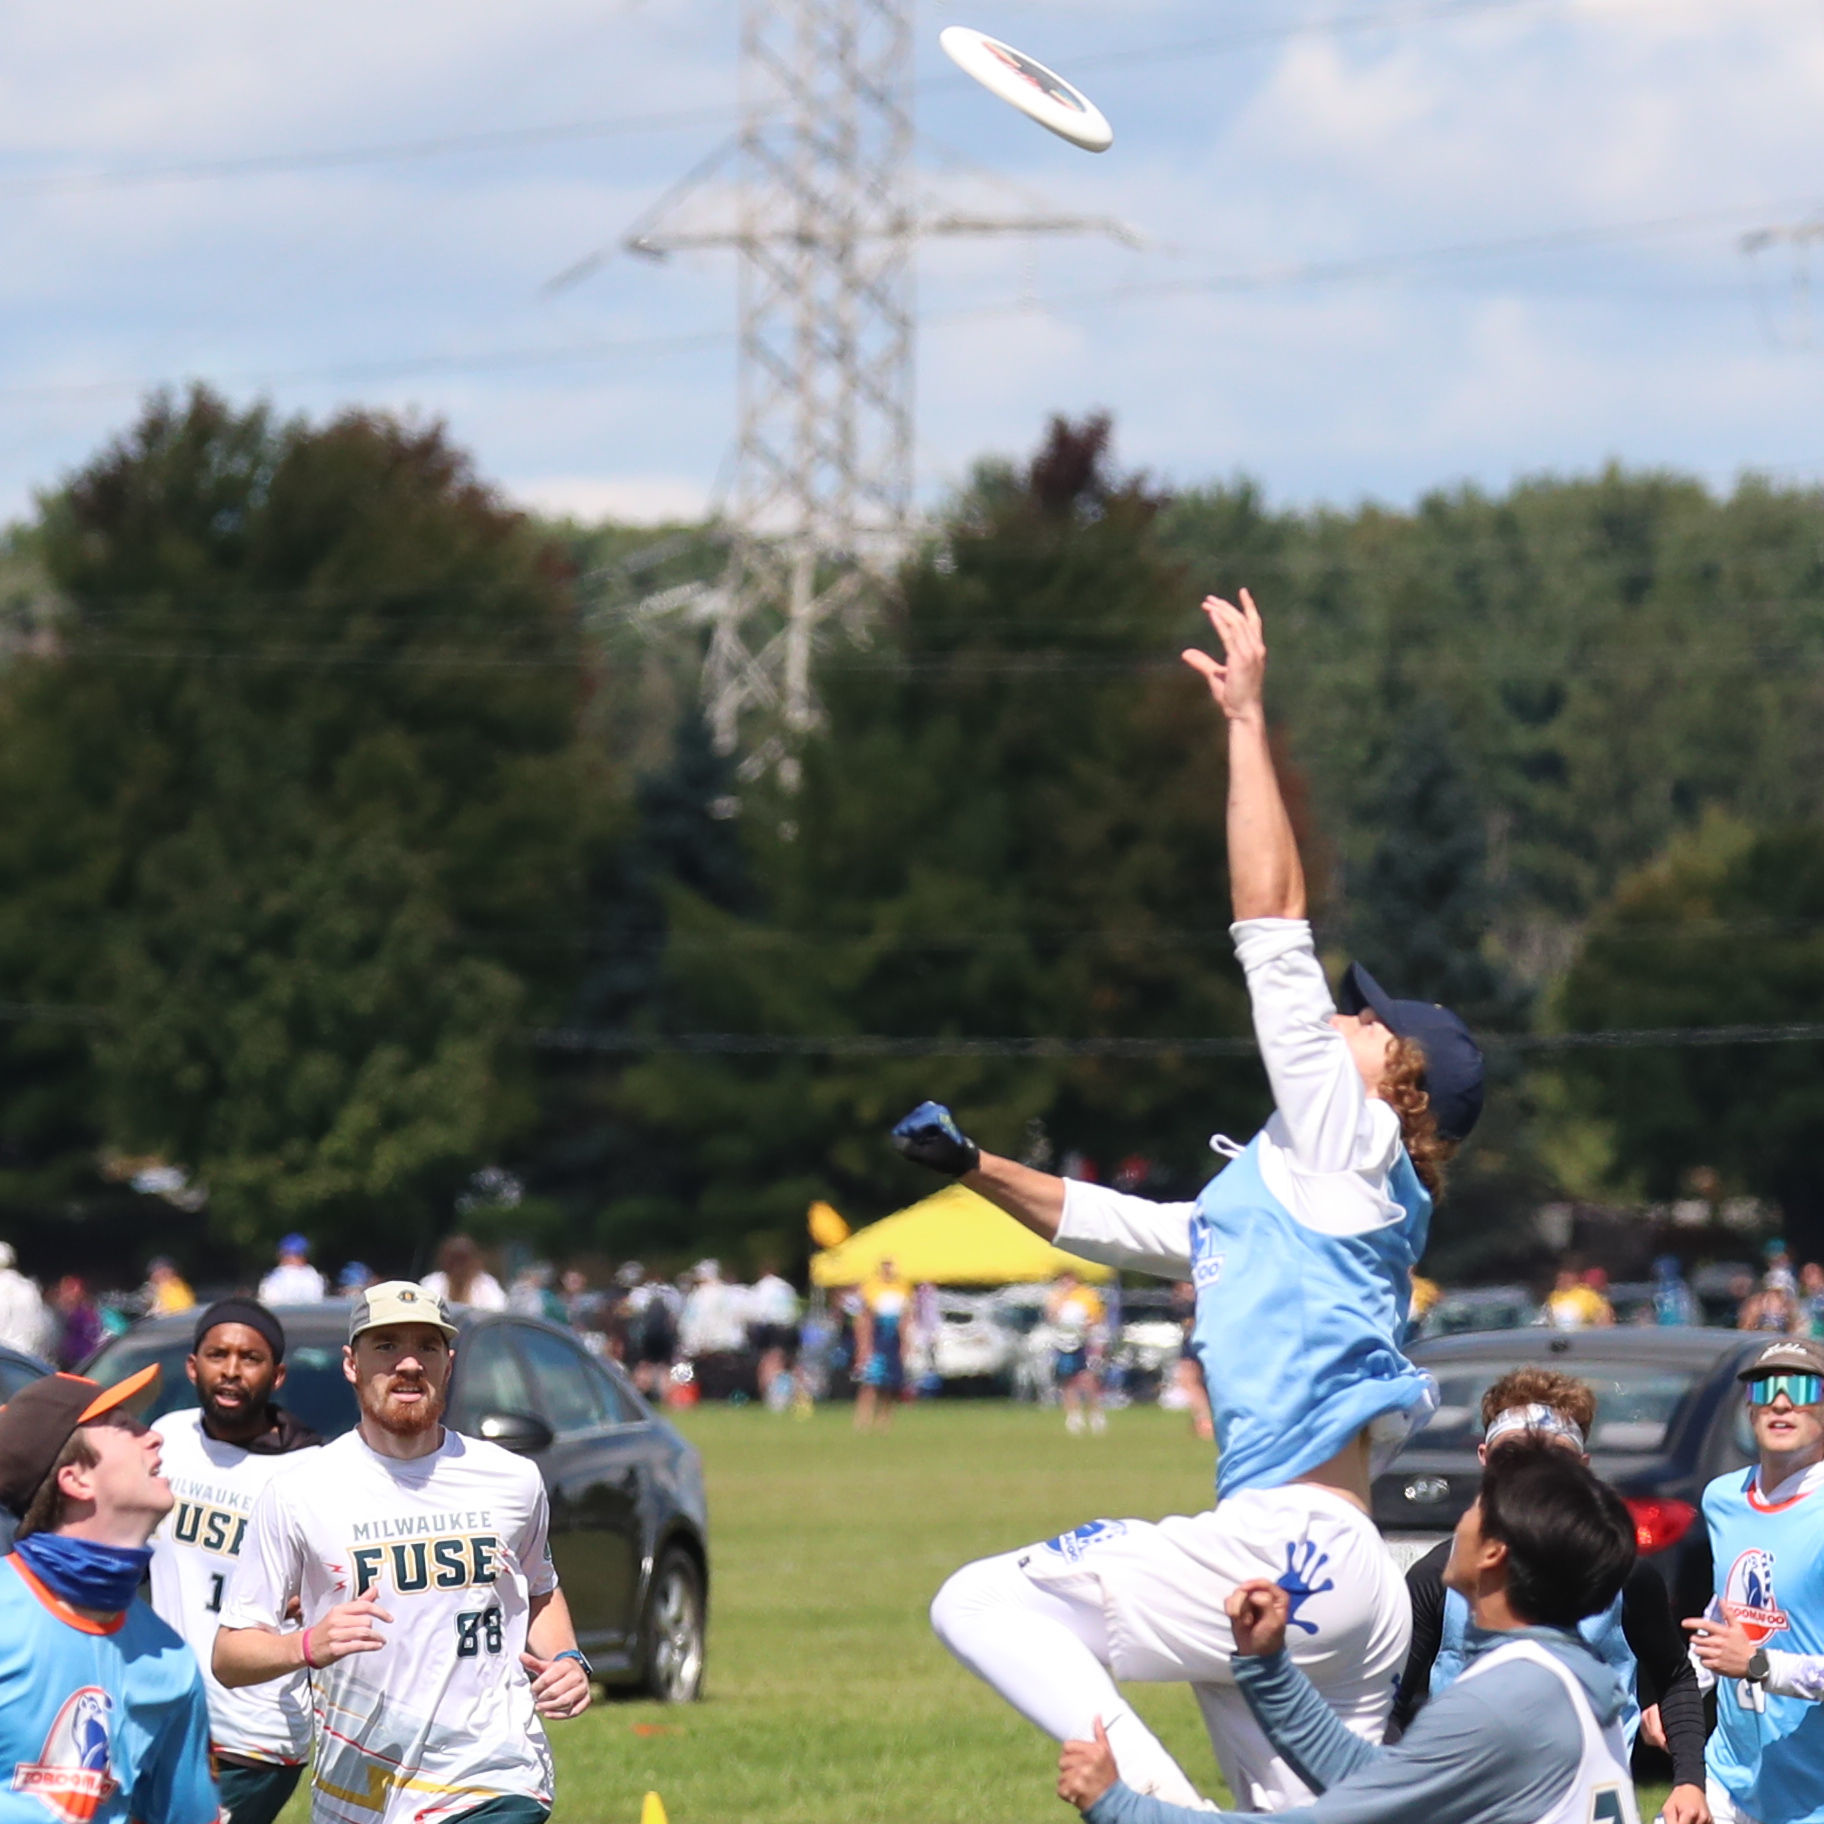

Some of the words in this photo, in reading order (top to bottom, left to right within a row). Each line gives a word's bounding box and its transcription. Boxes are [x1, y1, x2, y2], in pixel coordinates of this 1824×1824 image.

[169, 1477, 253, 1512] ILWAUKE
[352, 1510, 493, 1543] MILWAUKEE
[350, 1534, 498, 1598] FUSE
[456, 1606, 503, 1659] 88
